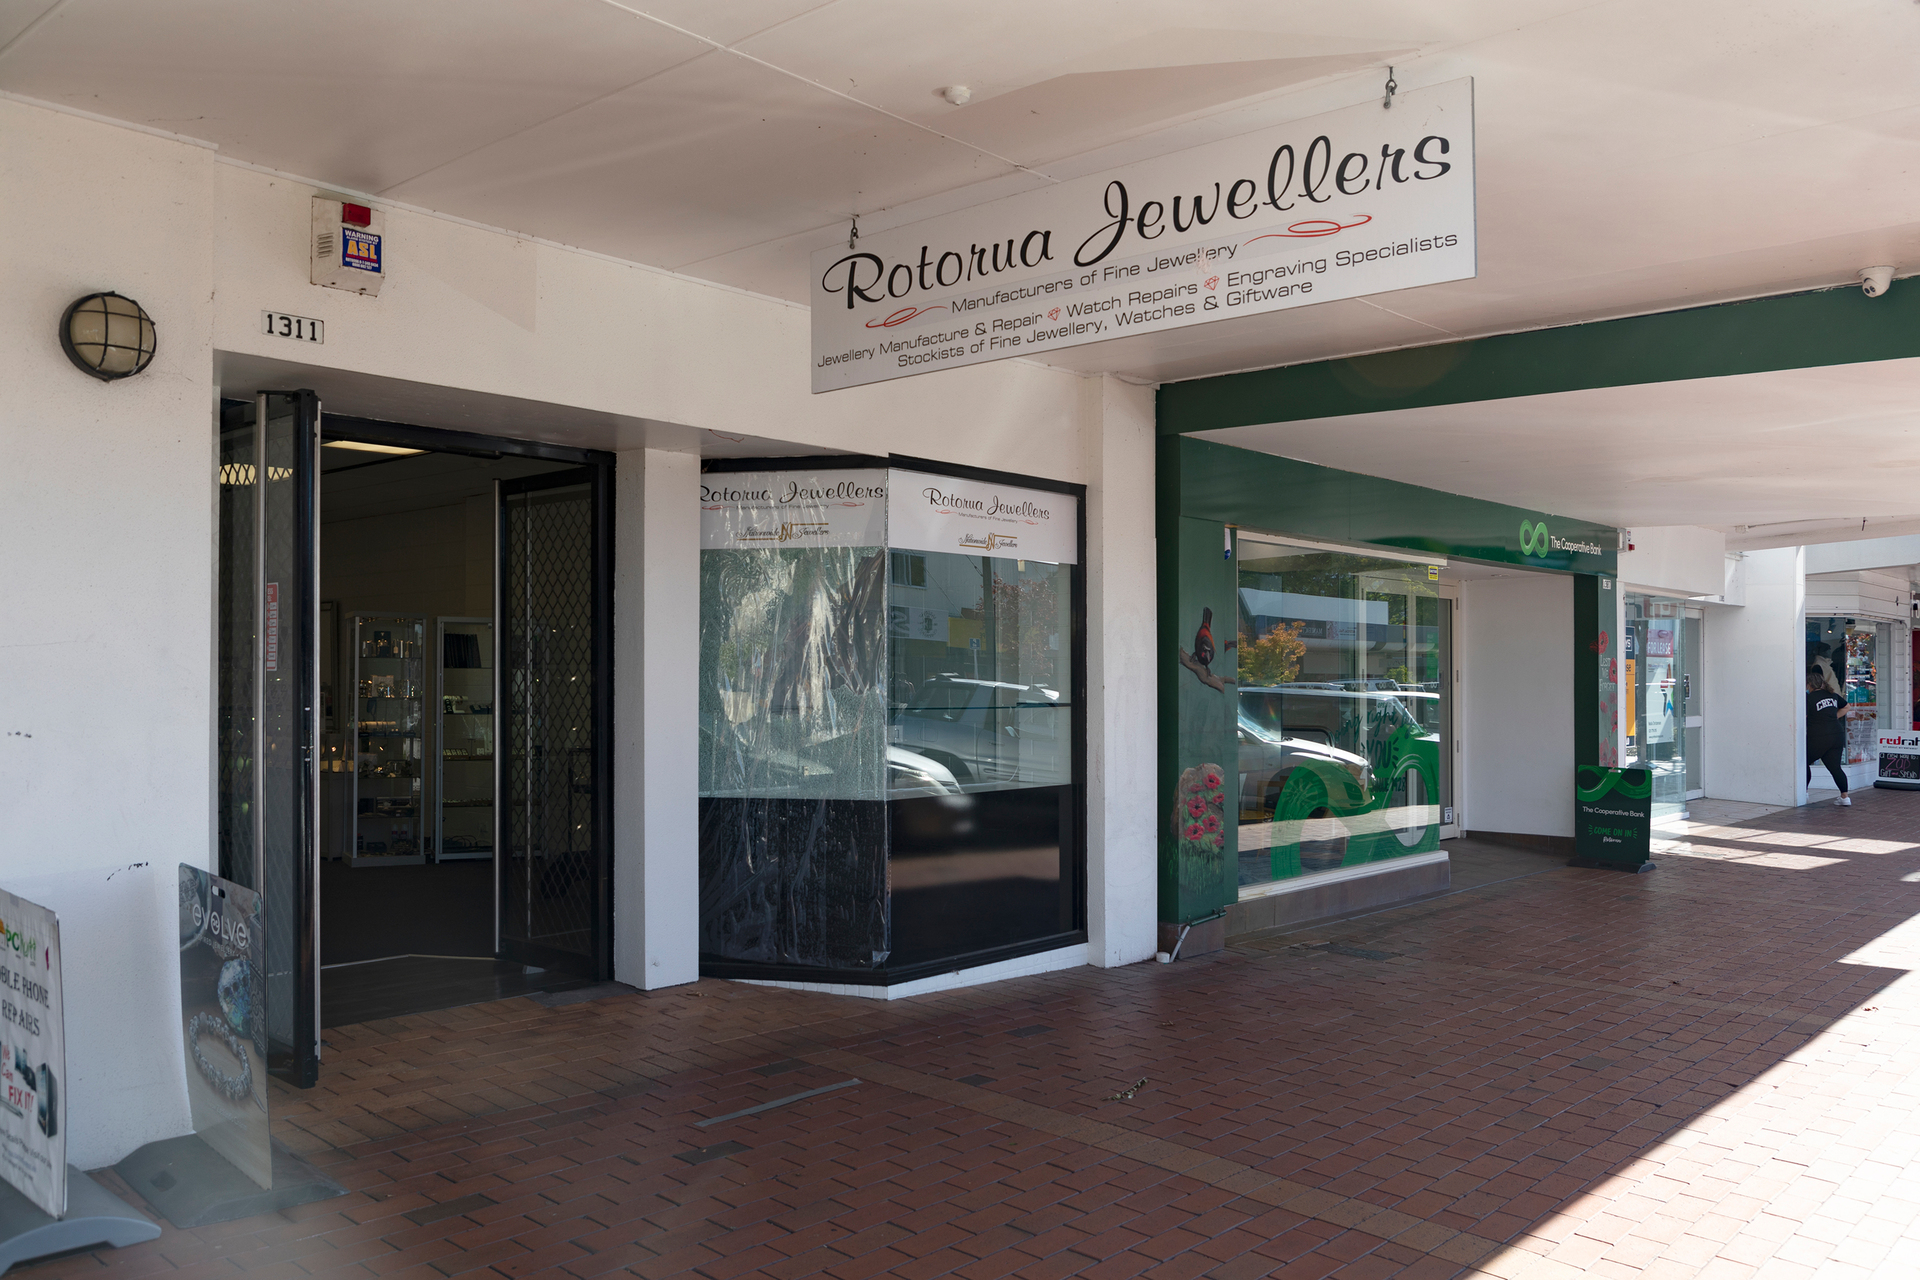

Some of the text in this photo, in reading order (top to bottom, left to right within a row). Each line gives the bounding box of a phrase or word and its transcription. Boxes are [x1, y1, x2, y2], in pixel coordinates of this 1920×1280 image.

[822, 135, 1451, 309] Rotorua Jewellers
[345, 229, 379, 243] WARNING
[347, 240, 377, 259] ASL
[952, 244, 1238, 314] Manufacturers of Fine Jewellery
[817, 233, 1458, 368] Jewellery Manufacture & Repair Watch Repairs Engraving Specialists
[267, 313, 317, 341] 1311
[898, 280, 1313, 367] Stockists of Fine Jewellery, Watches & Giftware
[779, 480, 884, 503] Jewellers
[922, 487, 1050, 520] Rotorua Jewellers
[958, 512, 987, 520] Manufacturers
[1550, 535, 1602, 556] The Cooperative Bank
[1648, 641, 1671, 655] FOR LEASE
[1816, 698, 1838, 712] CREW
[1366, 739, 1392, 769] YOU
[1594, 807, 1629, 816] Cooperative
[1629, 810, 1645, 818] Bank
[1594, 826, 1633, 837] COME ON IN
[22, 976, 50, 1010] PHONE
[2, 999, 40, 1036] REPAIRS
[8, 1085, 23, 1109] FIX
